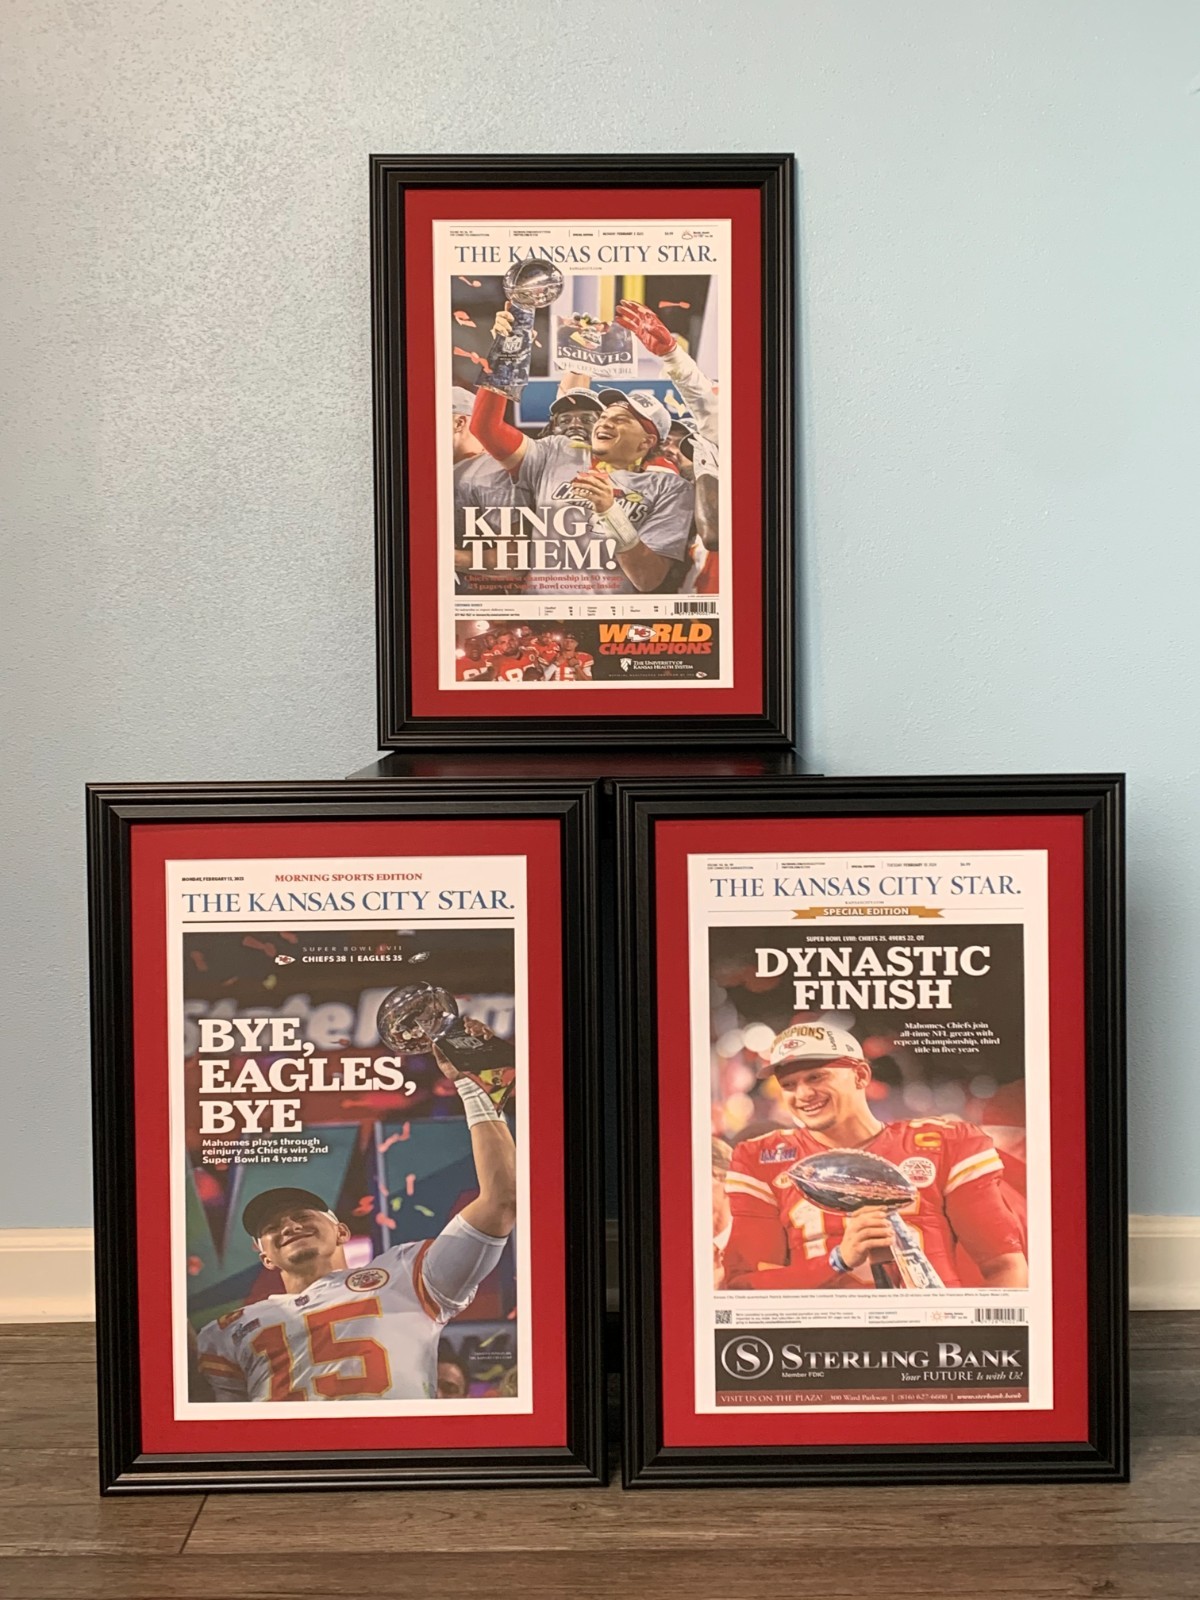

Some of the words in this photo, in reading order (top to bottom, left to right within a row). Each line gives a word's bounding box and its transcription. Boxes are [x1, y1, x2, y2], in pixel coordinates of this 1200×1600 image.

[454, 246, 501, 263] THE
[508, 245, 591, 263] KANSAS
[598, 245, 651, 263] CITY
[658, 245, 717, 263] STAR.
[558, 346, 632, 364] CHAMPS!
[462, 506, 588, 538] KING
[462, 538, 617, 570] THEM!
[539, 582, 558, 590] Bowl
[560, 584, 594, 592] coverage
[599, 642, 713, 655] CHAMPIONS
[275, 874, 330, 882] MORNING
[376, 873, 423, 881] EDITION
[710, 878, 764, 897] THE
[773, 876, 870, 897] KANSAS
[879, 876, 943, 896] CITY
[951, 875, 1022, 895] STAR.
[182, 893, 241, 913] THE
[248, 892, 356, 912] KANSAS
[362, 891, 430, 911] CITY
[438, 890, 515, 910] STAR.
[823, 908, 864, 916] SPECIAL
[866, 908, 909, 916] EDITION
[302, 955, 335, 963] CHIEFS
[755, 946, 990, 978] DYNASTIC
[793, 979, 952, 1010] FINISH
[904, 1022, 945, 1030] Mahomes,
[972, 1022, 989, 1030] join
[949, 1030, 975, 1038] greats
[198, 1017, 315, 1057] BYE,
[893, 1039, 920, 1047] repeat
[921, 1038, 979, 1046] championship,
[980, 1037, 1000, 1045] third
[198, 1056, 417, 1096] EAGLES,
[199, 1099, 302, 1134] BYE
[202, 1138, 250, 1147] Mahomes
[252, 1138, 278, 1149] plays
[280, 1137, 320, 1148] through
[202, 1147, 242, 1156] reinjury
[257, 1146, 288, 1154] Chiefs
[290, 1146, 308, 1154] win
[309, 1145, 329, 1154] 2nd
[202, 1156, 232, 1164] Super
[234, 1155, 260, 1164] Bowl
[280, 1156, 308, 1164] years
[251, 1297, 393, 1402] 15
[736, 1342, 761, 1372] S
[782, 1343, 930, 1370] STERLING
[936, 1342, 1023, 1368] BANK
[901, 1372, 922, 1382] Your
[923, 1371, 974, 1381] FUTURE
[976, 1372, 984, 1380] Is
[984, 1371, 1006, 1380] with
[775, 1394, 793, 1402] THE
[862, 1394, 888, 1402] Parkway
